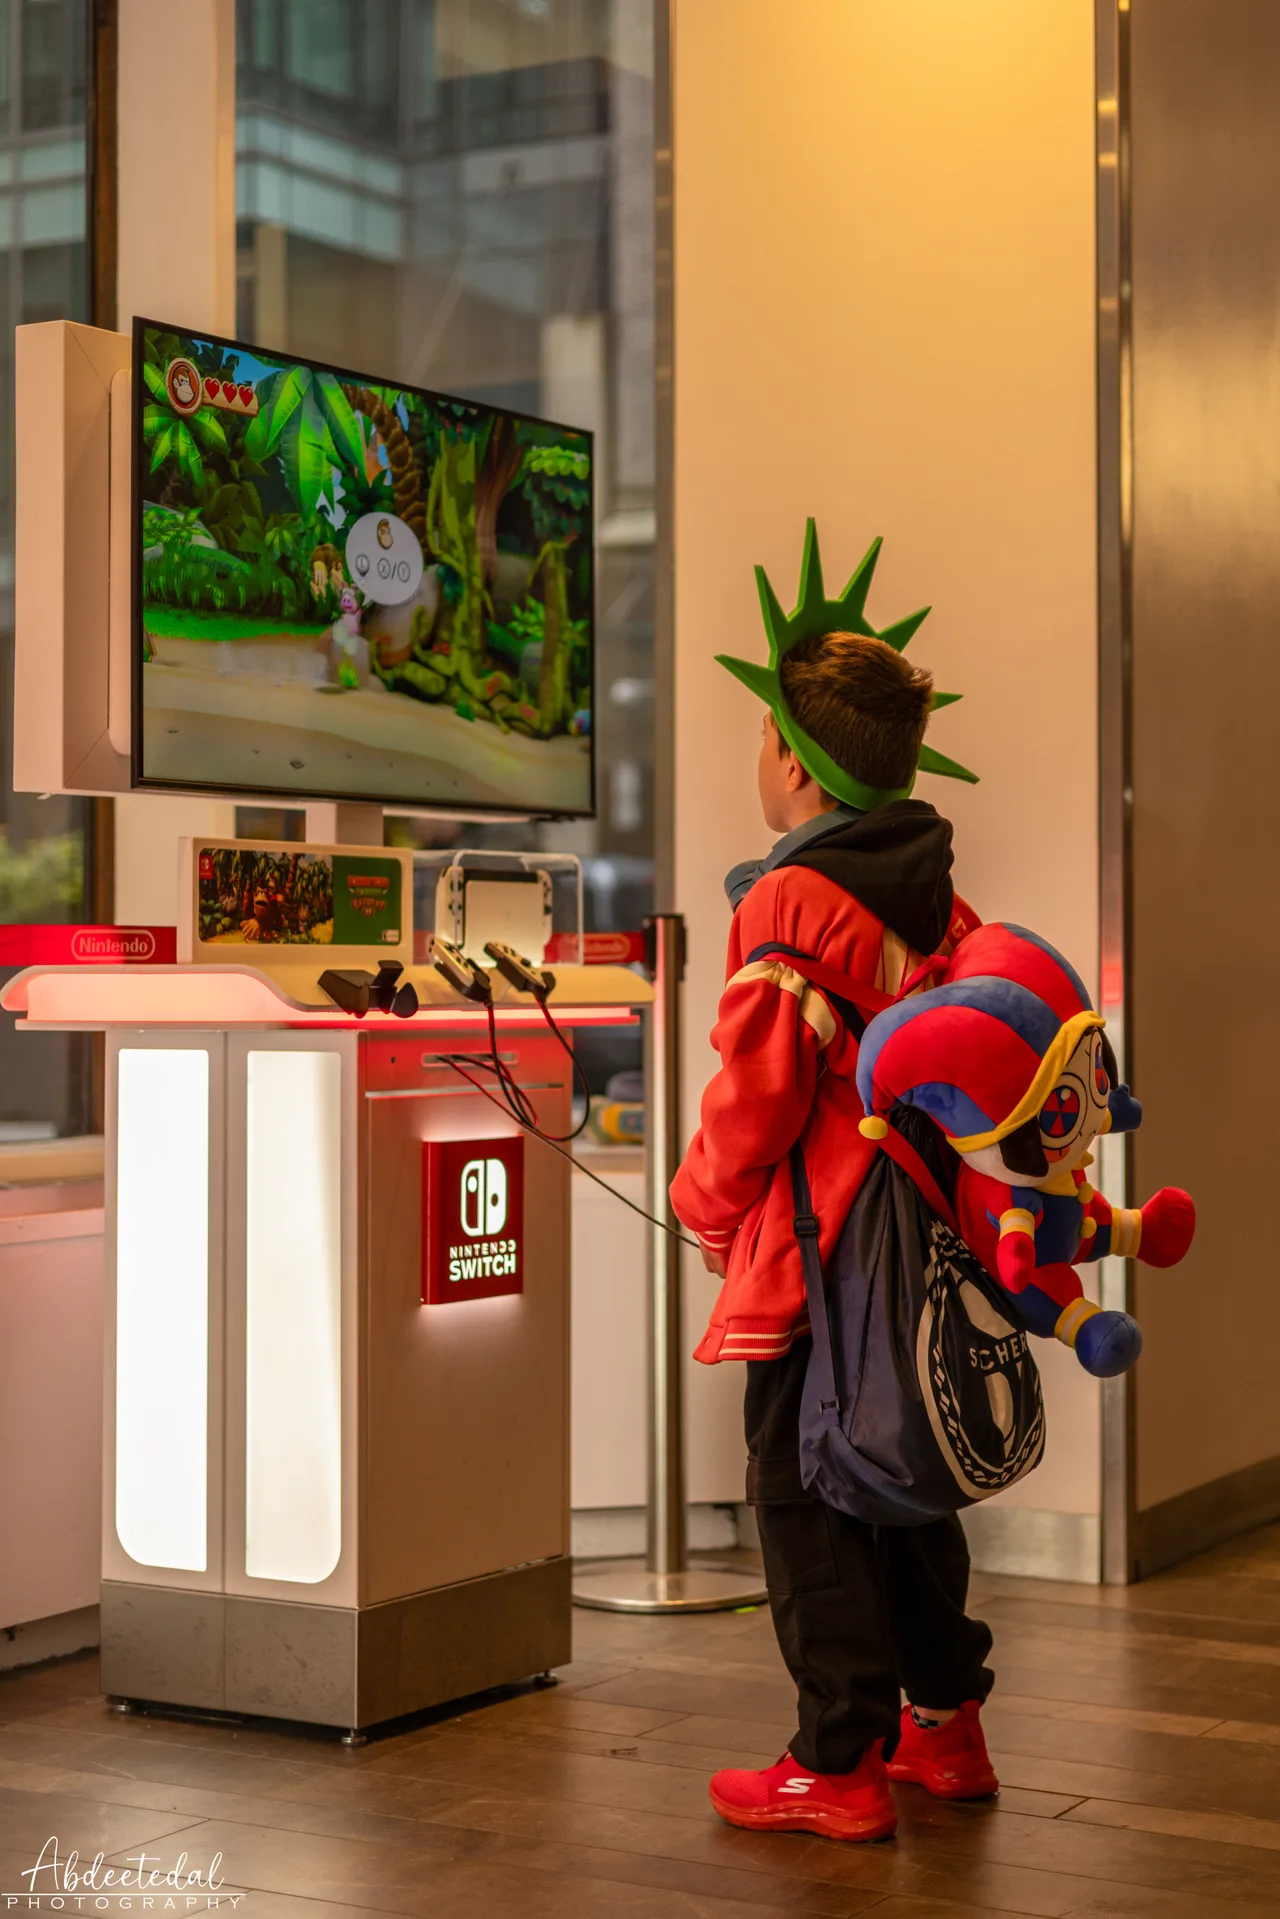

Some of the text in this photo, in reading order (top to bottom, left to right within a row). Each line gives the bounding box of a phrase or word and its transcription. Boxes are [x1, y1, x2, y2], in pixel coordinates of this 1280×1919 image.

[79, 936, 148, 953] Nintendo
[449, 1239, 517, 1259] NINTENDO
[449, 1253, 517, 1282] SWITCH
